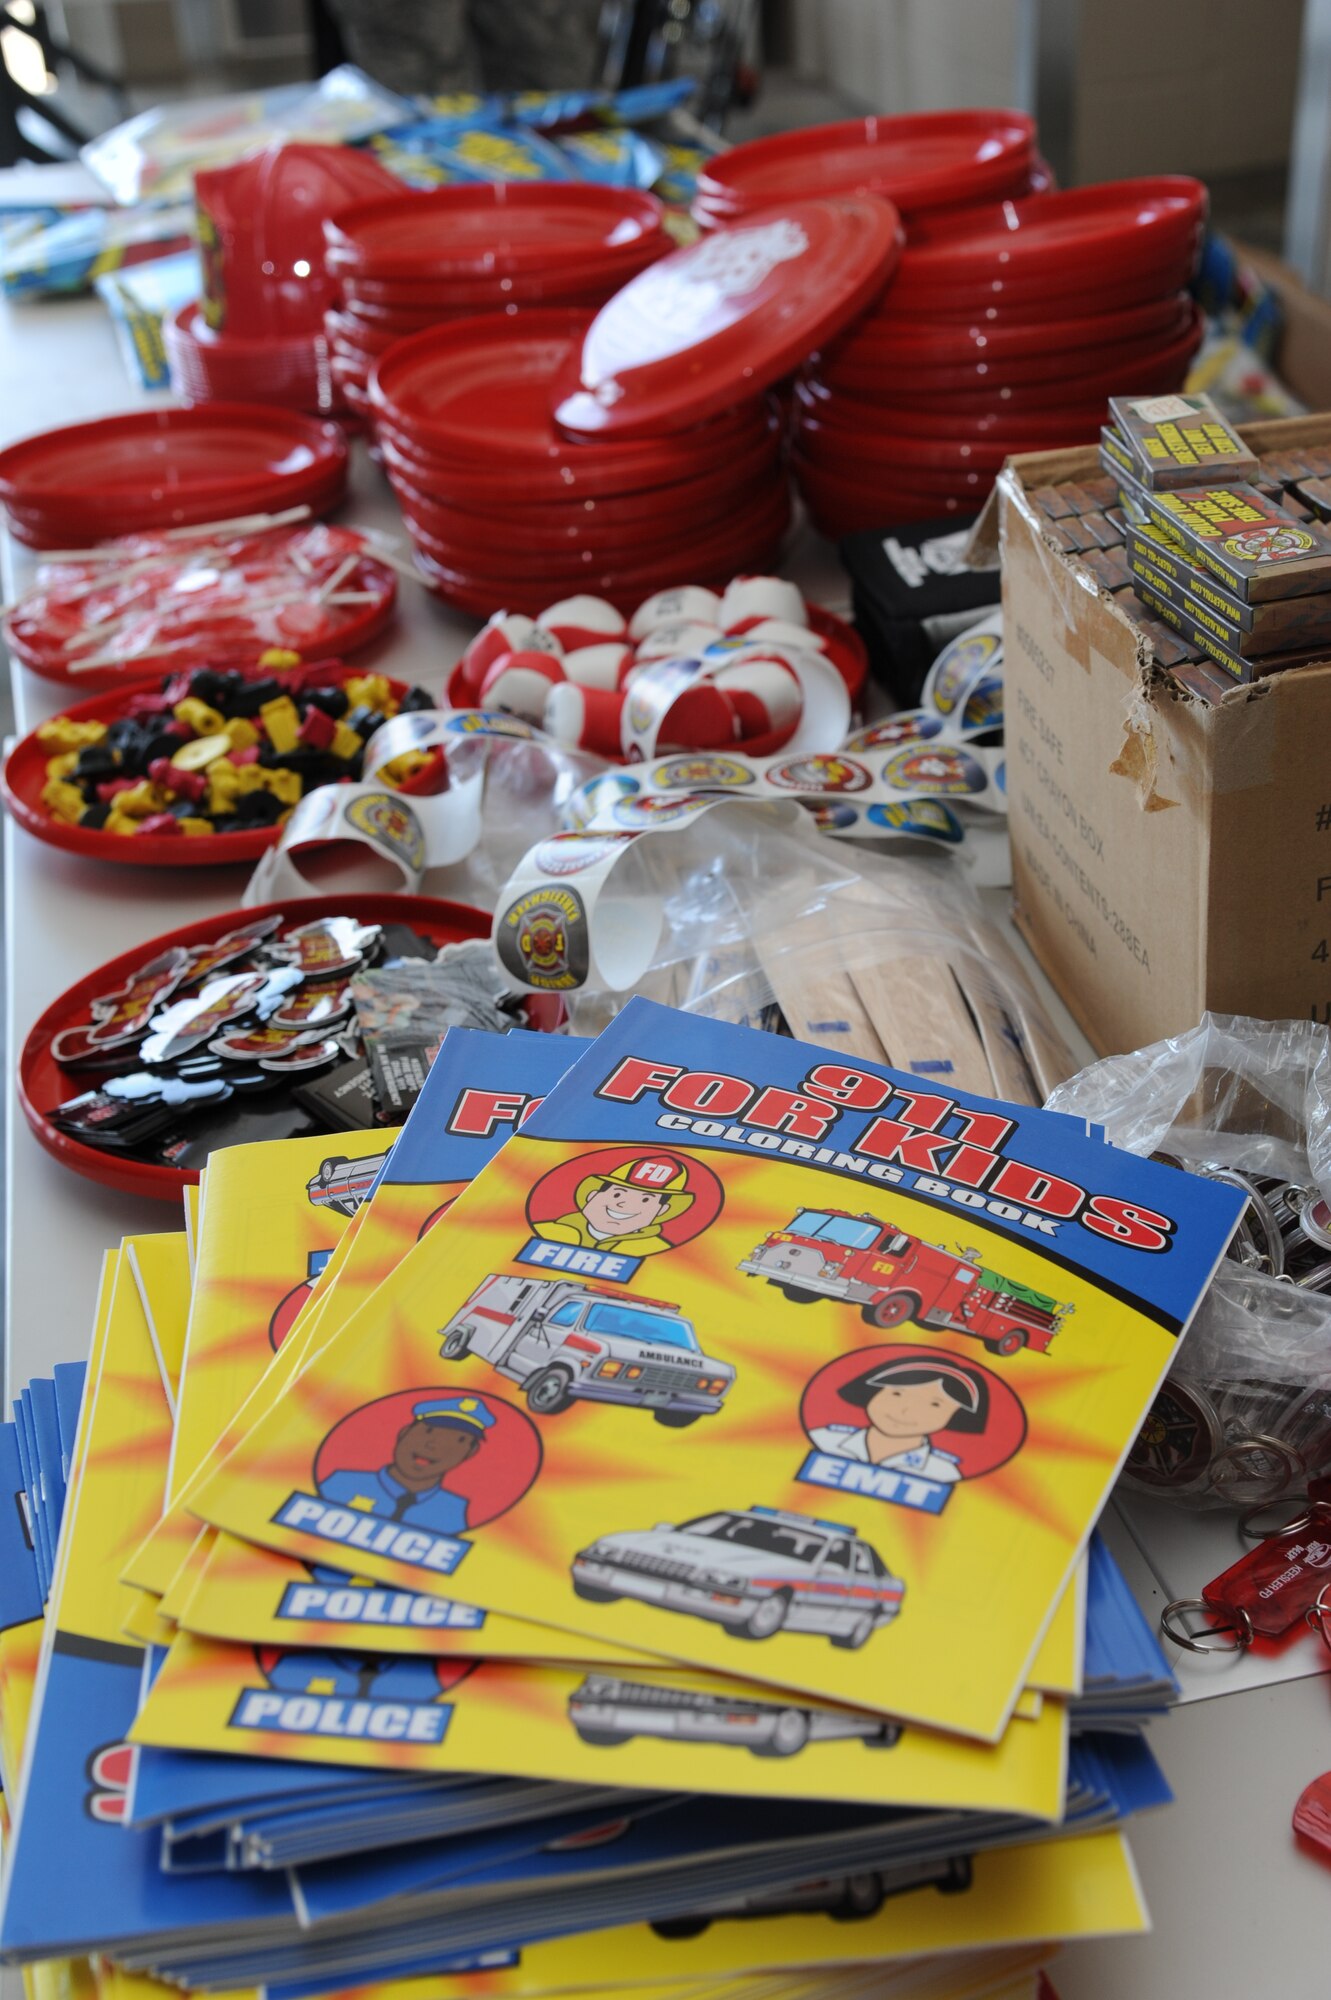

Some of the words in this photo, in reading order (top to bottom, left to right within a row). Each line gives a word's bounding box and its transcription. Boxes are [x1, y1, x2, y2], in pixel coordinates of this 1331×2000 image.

[1188, 500, 1236, 523] PLACE
[1205, 490, 1245, 507] SAFE
[1177, 513, 1224, 537] COLOR
[1232, 507, 1267, 523] FIRE
[1080, 813, 1104, 863] BOX
[802, 1061, 1020, 1155] 911
[593, 1055, 842, 1142] FOR
[850, 1115, 1179, 1254] KIDS
[635, 1161, 673, 1184] FD
[656, 1112, 905, 1185] COLORING
[911, 1174, 1063, 1239] BOOK
[529, 1242, 628, 1278] FIRE
[871, 1260, 895, 1276] FD
[638, 1349, 705, 1369] AMBULANCE
[806, 1454, 943, 1507] EMT
[282, 1497, 462, 1572] POLICE
[1258, 1587, 1274, 1599] FD
[1268, 1563, 1304, 1592] KEESLER
[286, 1586, 478, 1627] POLICE
[239, 1691, 445, 1743] POLICE
